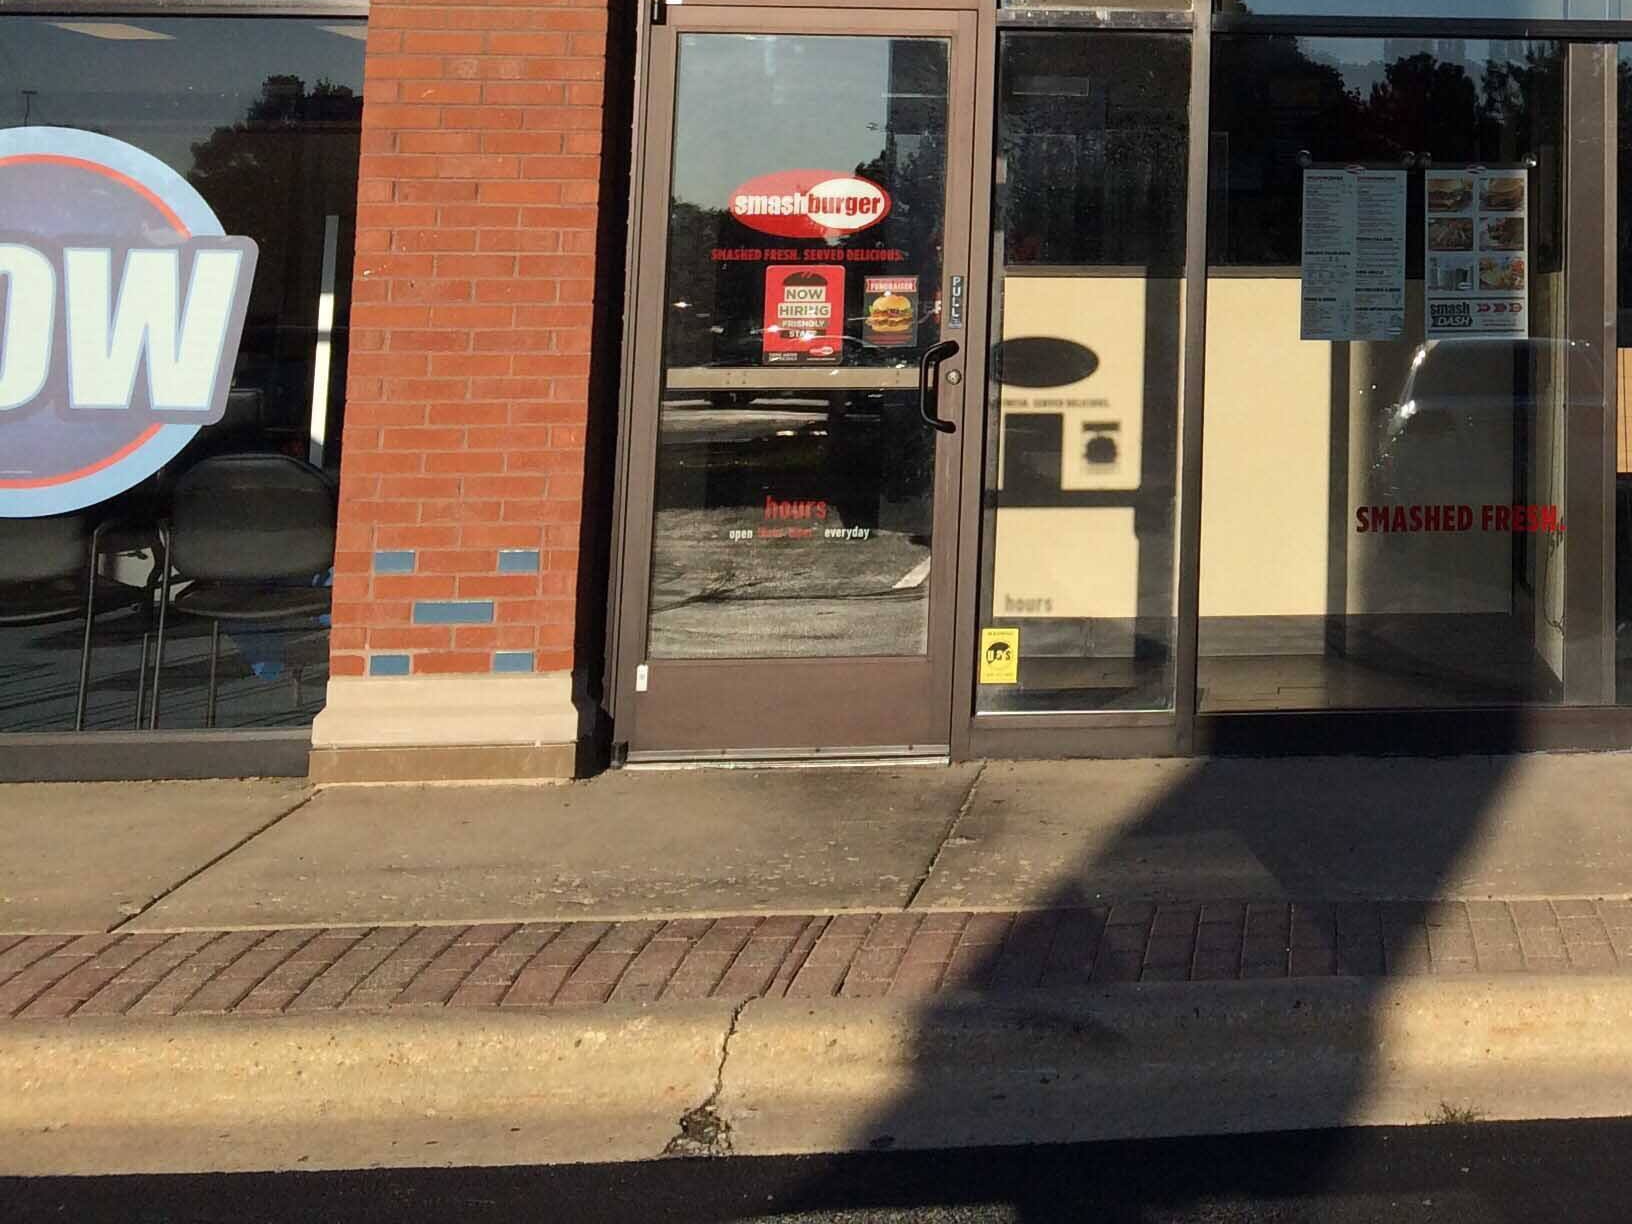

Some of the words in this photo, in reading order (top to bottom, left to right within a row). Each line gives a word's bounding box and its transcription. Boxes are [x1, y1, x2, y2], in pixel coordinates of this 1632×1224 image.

[734, 191, 881, 216] smashburger
[711, 248, 762, 261] SMASHED
[803, 249, 844, 261] SERVED
[786, 288, 823, 300] NOW
[951, 276, 961, 318] PULL
[779, 305, 830, 317] HIRING
[1430, 302, 1470, 315] smash
[1438, 316, 1470, 326] DASH
[764, 495, 828, 520] hours
[1356, 504, 1473, 533] SMASHED
[729, 529, 753, 542] open
[824, 526, 870, 541] everyday
